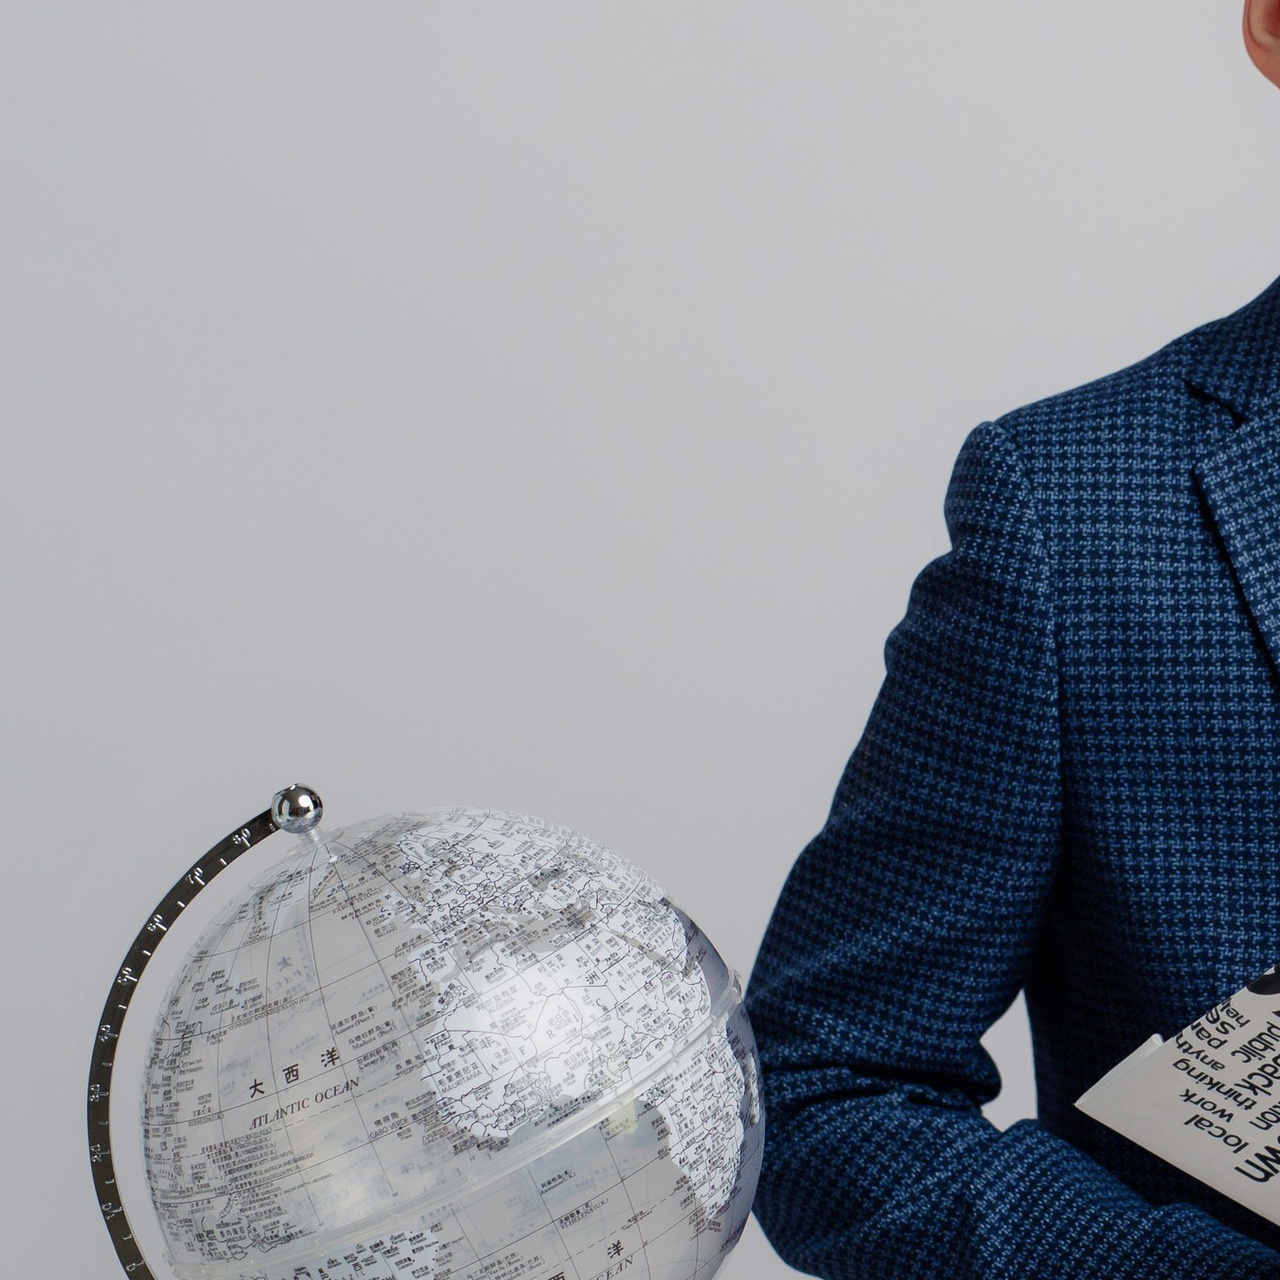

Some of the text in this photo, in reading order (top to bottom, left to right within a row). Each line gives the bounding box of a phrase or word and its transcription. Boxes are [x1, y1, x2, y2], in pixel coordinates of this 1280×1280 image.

[249, 1076, 360, 1130] ATLANTIC OCEAN
[1172, 1058, 1258, 1111] thinking
[1179, 1088, 1234, 1123] work
[1183, 1113, 1250, 1155] local
